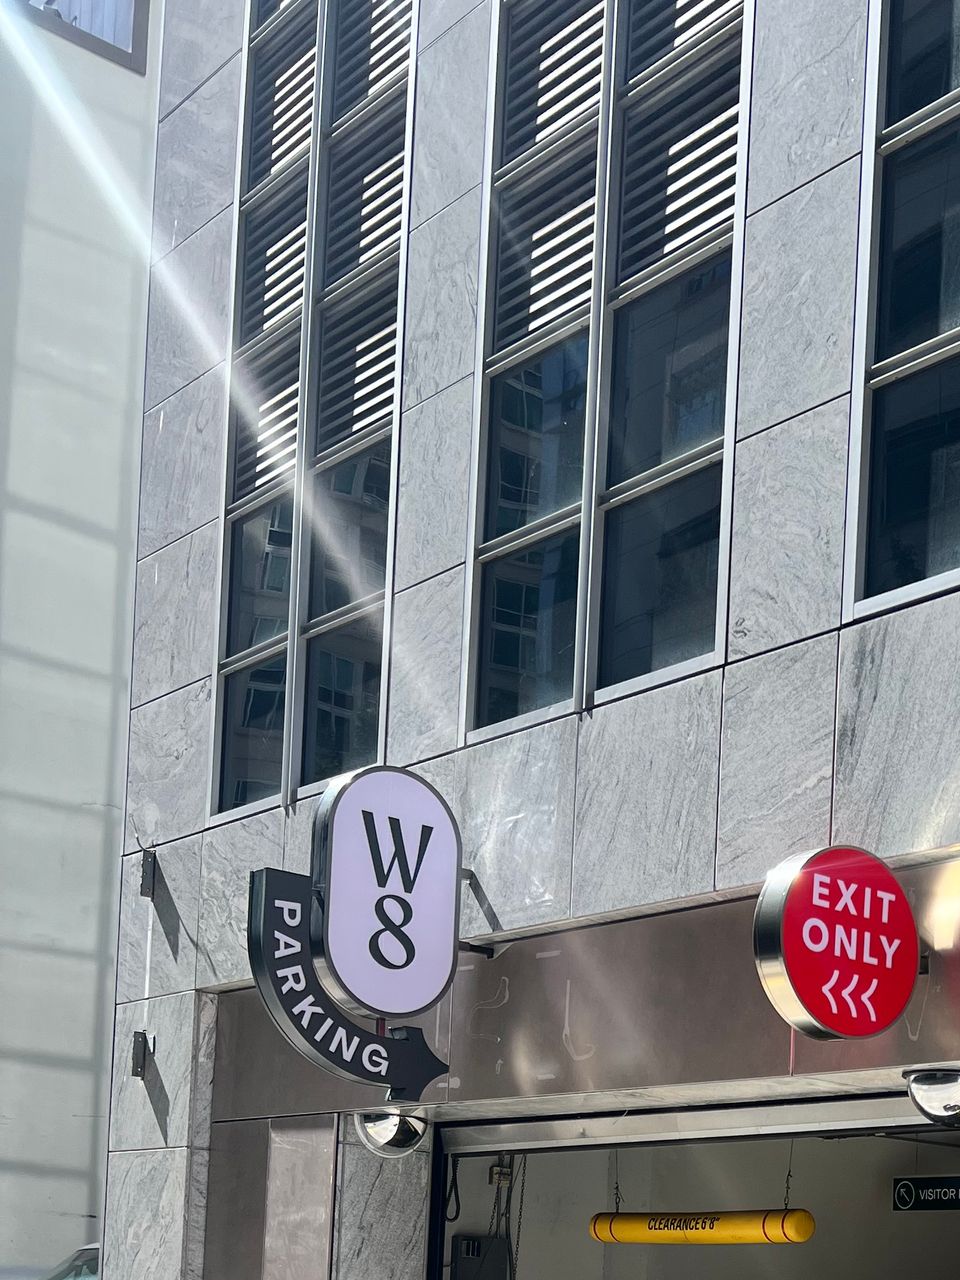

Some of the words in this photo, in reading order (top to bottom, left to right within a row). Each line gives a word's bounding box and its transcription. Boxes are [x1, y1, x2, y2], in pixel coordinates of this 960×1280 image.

[361, 809, 434, 894] W
[812, 873, 896, 924] EXIT
[368, 894, 416, 970] 8
[802, 917, 901, 969] ONLY
[272, 899, 391, 1076] PARKING
[919, 1188, 957, 1200] VISITOR
[647, 1217, 701, 1231] CLEARANCE
